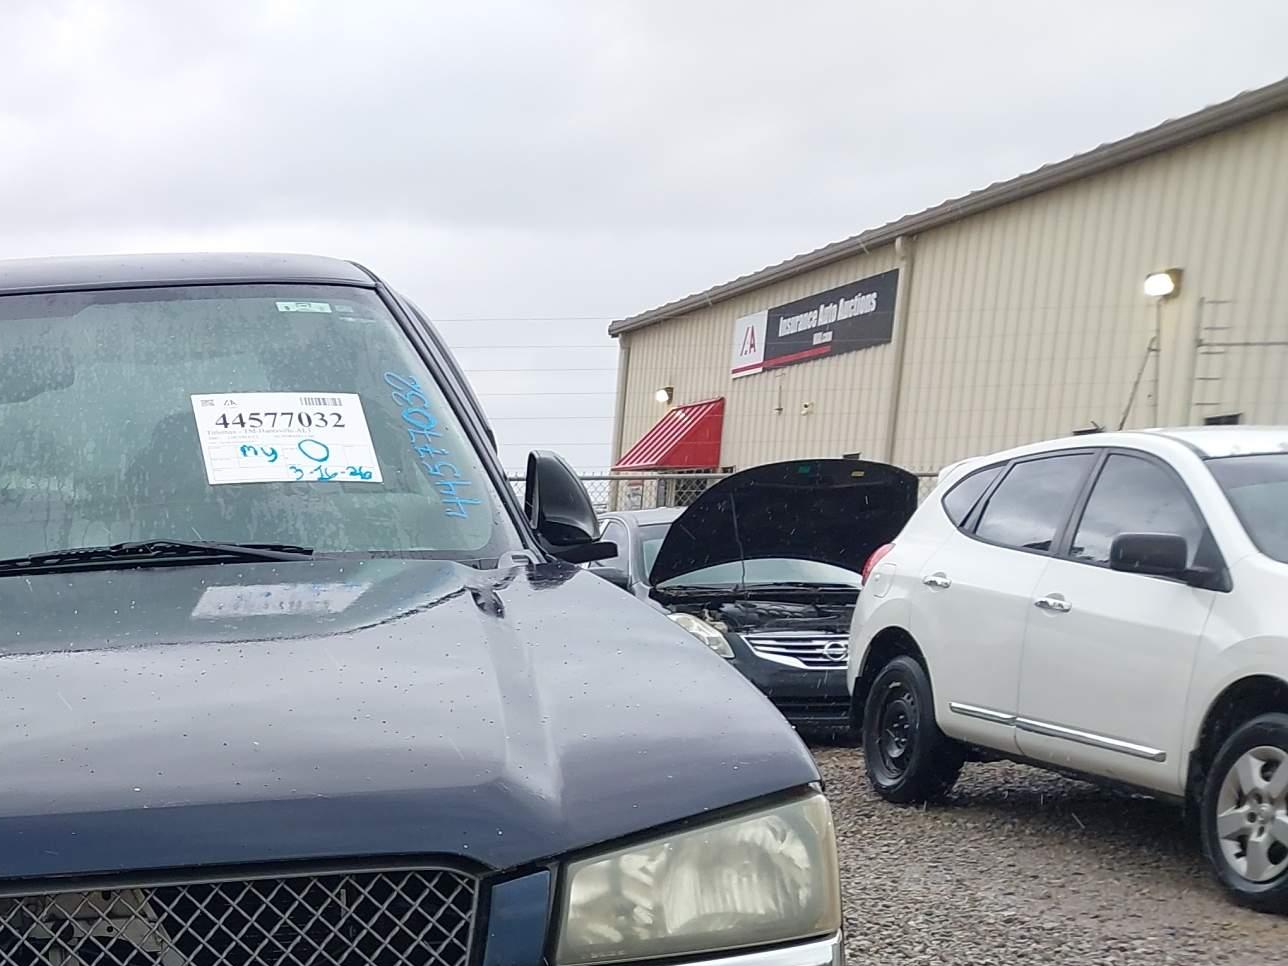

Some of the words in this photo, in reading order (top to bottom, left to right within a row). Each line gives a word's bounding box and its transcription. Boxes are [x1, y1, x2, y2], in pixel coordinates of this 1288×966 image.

[778, 309, 818, 337] Insurance
[817, 302, 838, 327] Auto
[837, 292, 878, 321] Auctions
[215, 412, 346, 429] 44577032
